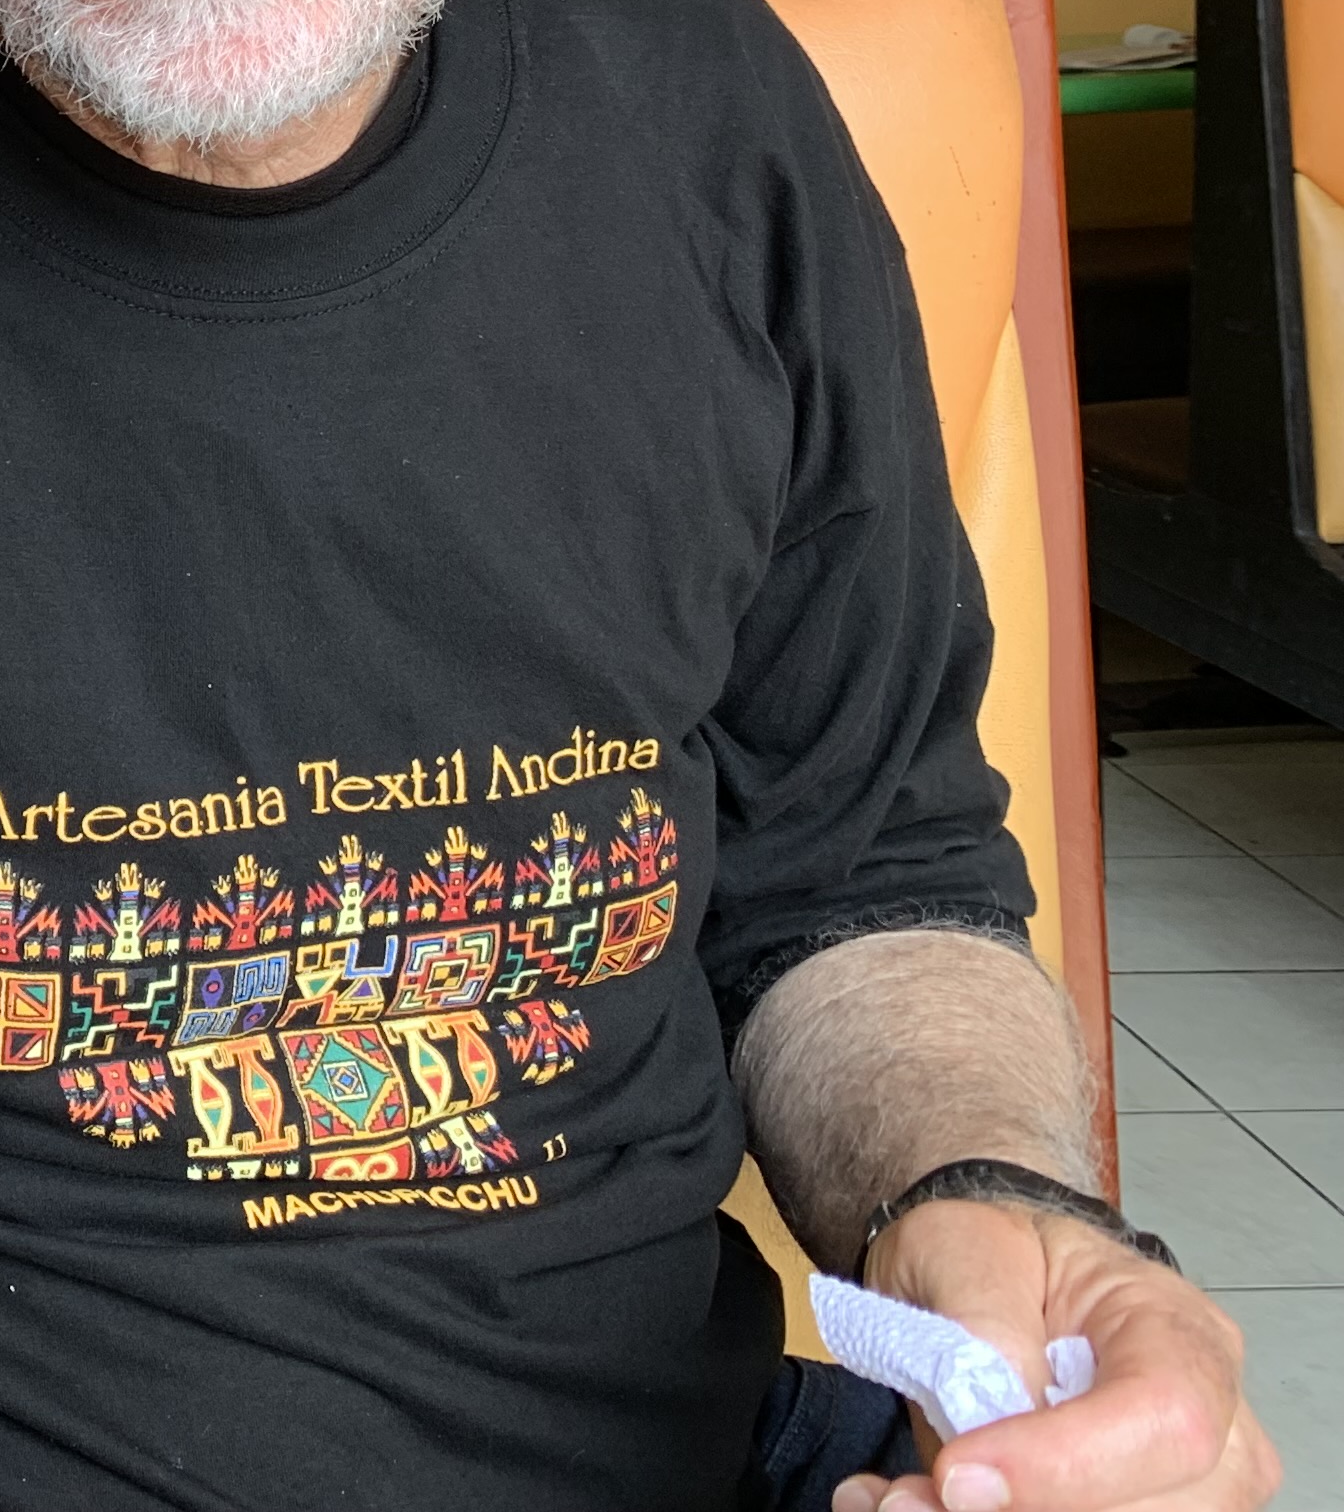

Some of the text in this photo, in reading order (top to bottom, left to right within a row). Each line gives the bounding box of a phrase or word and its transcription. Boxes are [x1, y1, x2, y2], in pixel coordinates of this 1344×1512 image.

[297, 748, 468, 815] Textil
[485, 724, 661, 801] Andina
[242, 1175, 540, 1231] MACHUPICCHU
